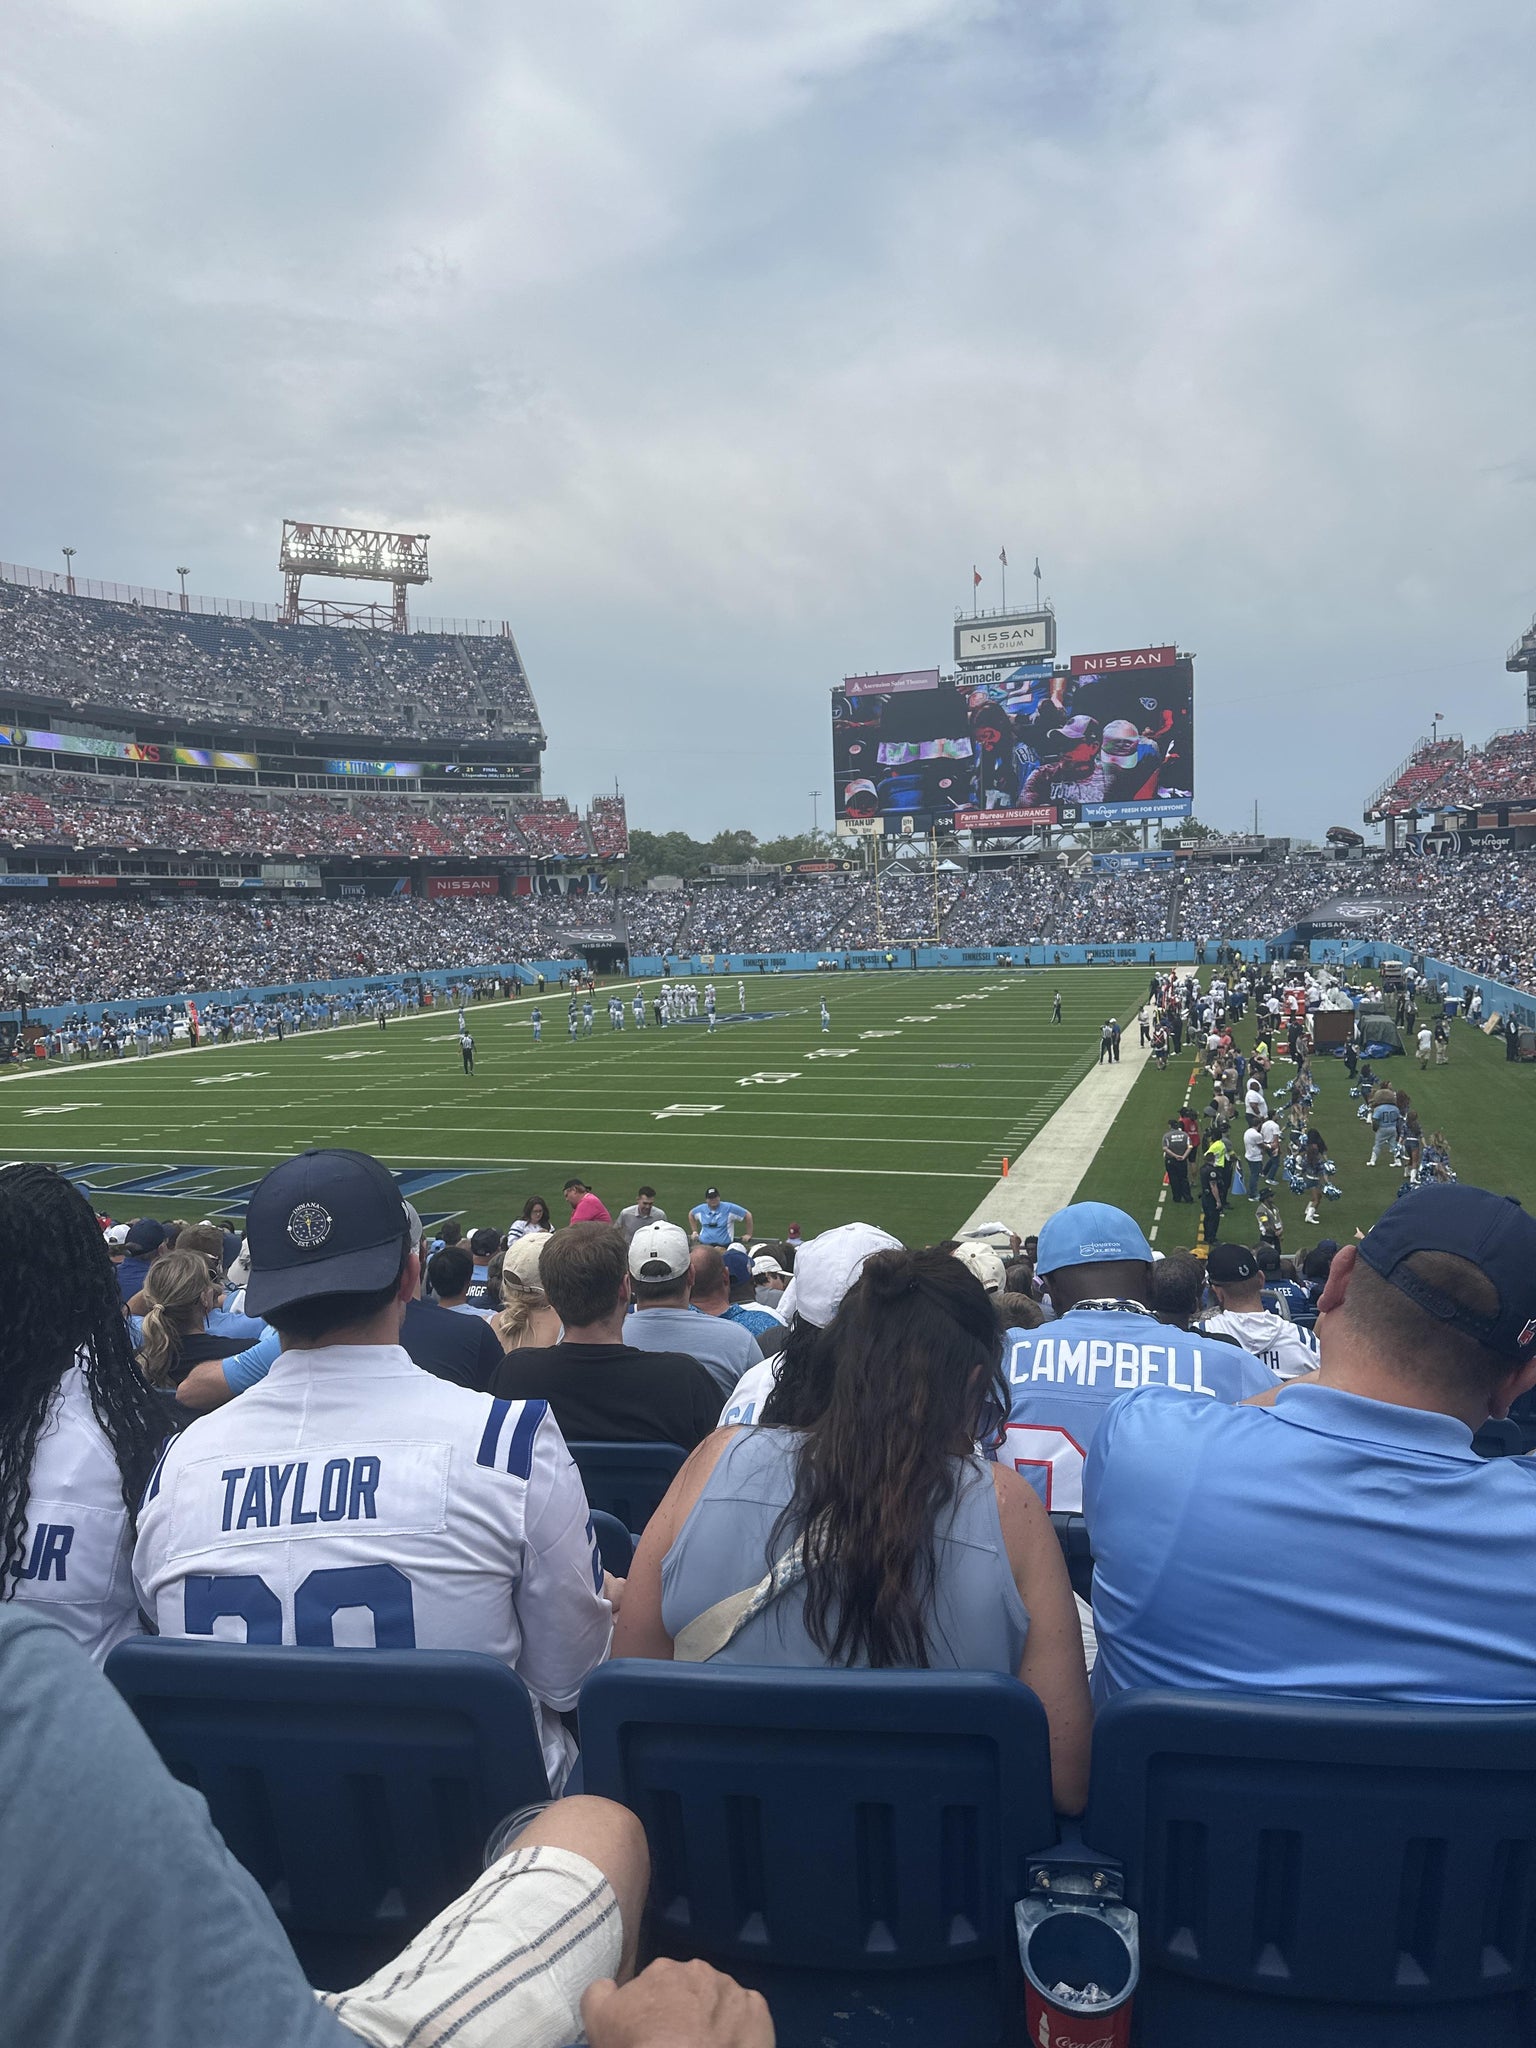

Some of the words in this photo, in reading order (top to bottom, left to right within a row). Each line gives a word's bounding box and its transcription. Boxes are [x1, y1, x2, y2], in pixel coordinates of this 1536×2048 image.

[970, 628, 1034, 643] NISSAN
[981, 641, 1024, 651] STADIUM
[1084, 653, 1161, 670] NISSAN
[955, 671, 1001, 685] Pinnacle
[135, 744, 160, 762] VS
[960, 813, 979, 822] Farm
[980, 811, 1004, 820] Bureau
[1005, 808, 1051, 818] INSURANCE
[1095, 805, 1118, 818] Kroger
[844, 819, 864, 827] TITAN
[1481, 833, 1511, 850] Kroger
[437, 881, 491, 890] NISSAN
[292, 1202, 320, 1215] INDIANA
[312, 1236, 326, 1246] 1816
[1010, 1338, 1216, 1398] CAMPBELL
[220, 1455, 382, 1532] TAYLOR
[10, 1523, 75, 1582] JR
